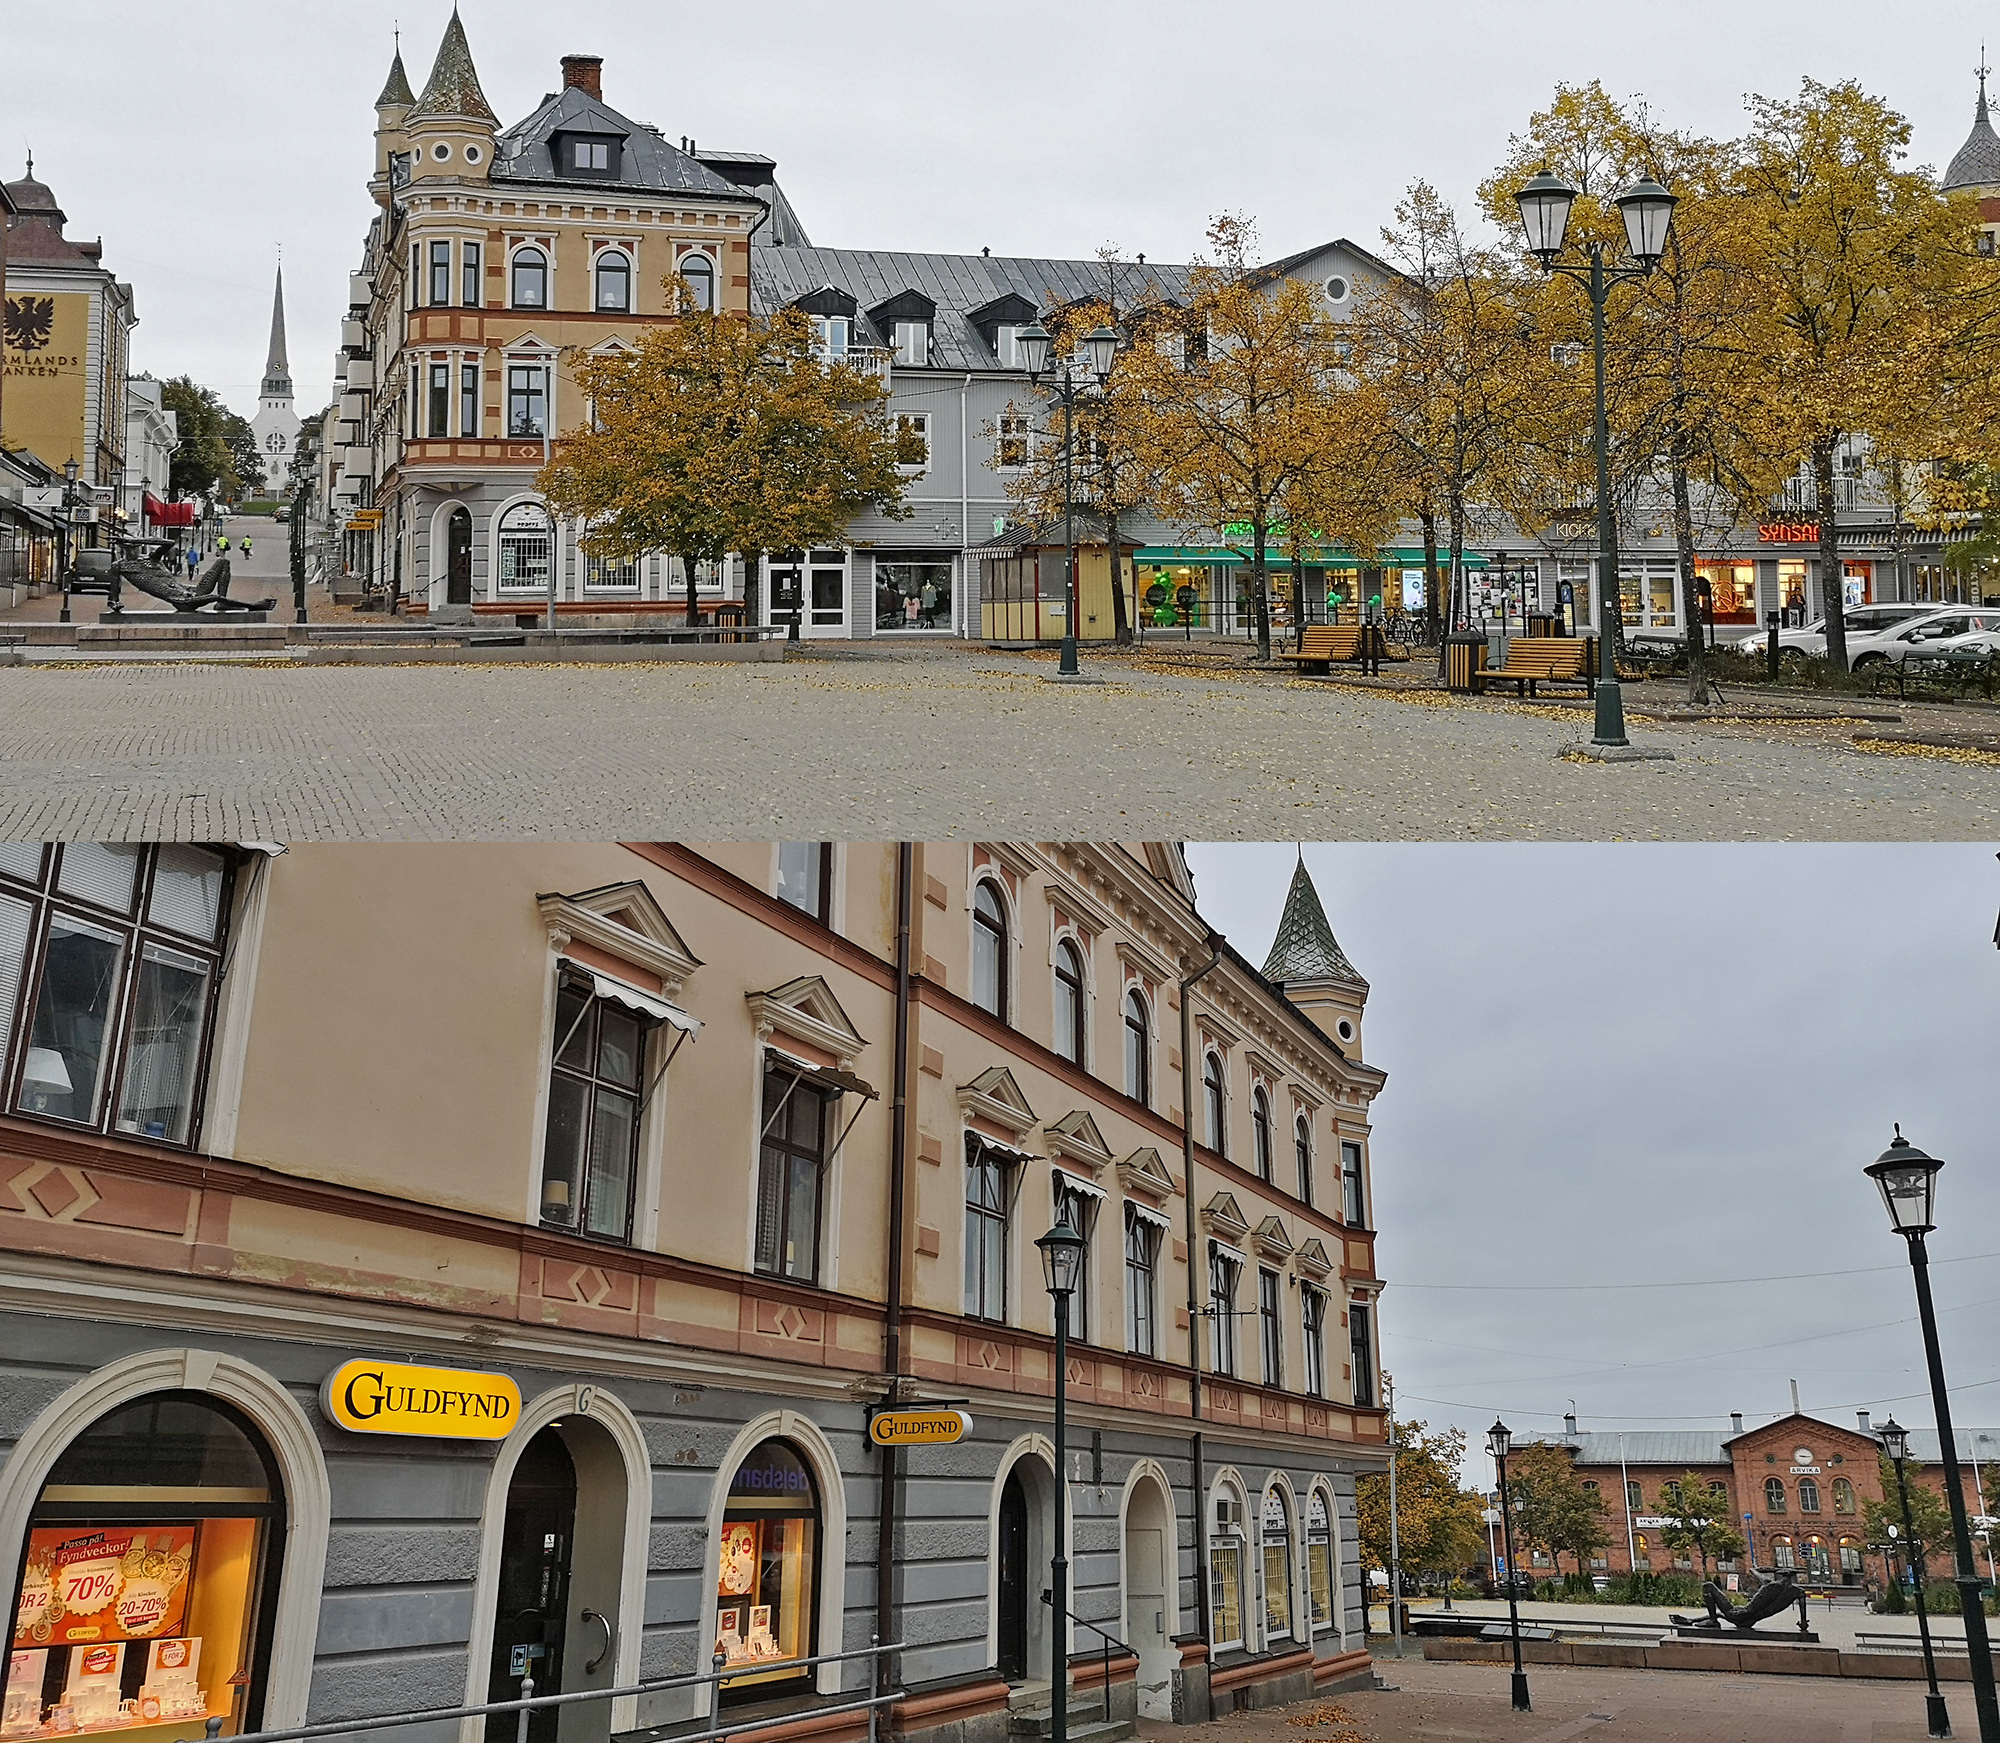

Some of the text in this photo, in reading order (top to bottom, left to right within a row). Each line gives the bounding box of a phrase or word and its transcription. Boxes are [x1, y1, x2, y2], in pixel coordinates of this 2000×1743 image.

[345, 1371, 510, 1420] GULDFYND
[876, 1417, 958, 1439] GULDFYND
[60, 1540, 130, 1564] Fyndveckor!
[64, 1534, 104, 1549] Passa på!
[66, 1572, 115, 1602] 70%
[36, 1592, 48, 1607] 2
[119, 1597, 167, 1615] 20-70%
